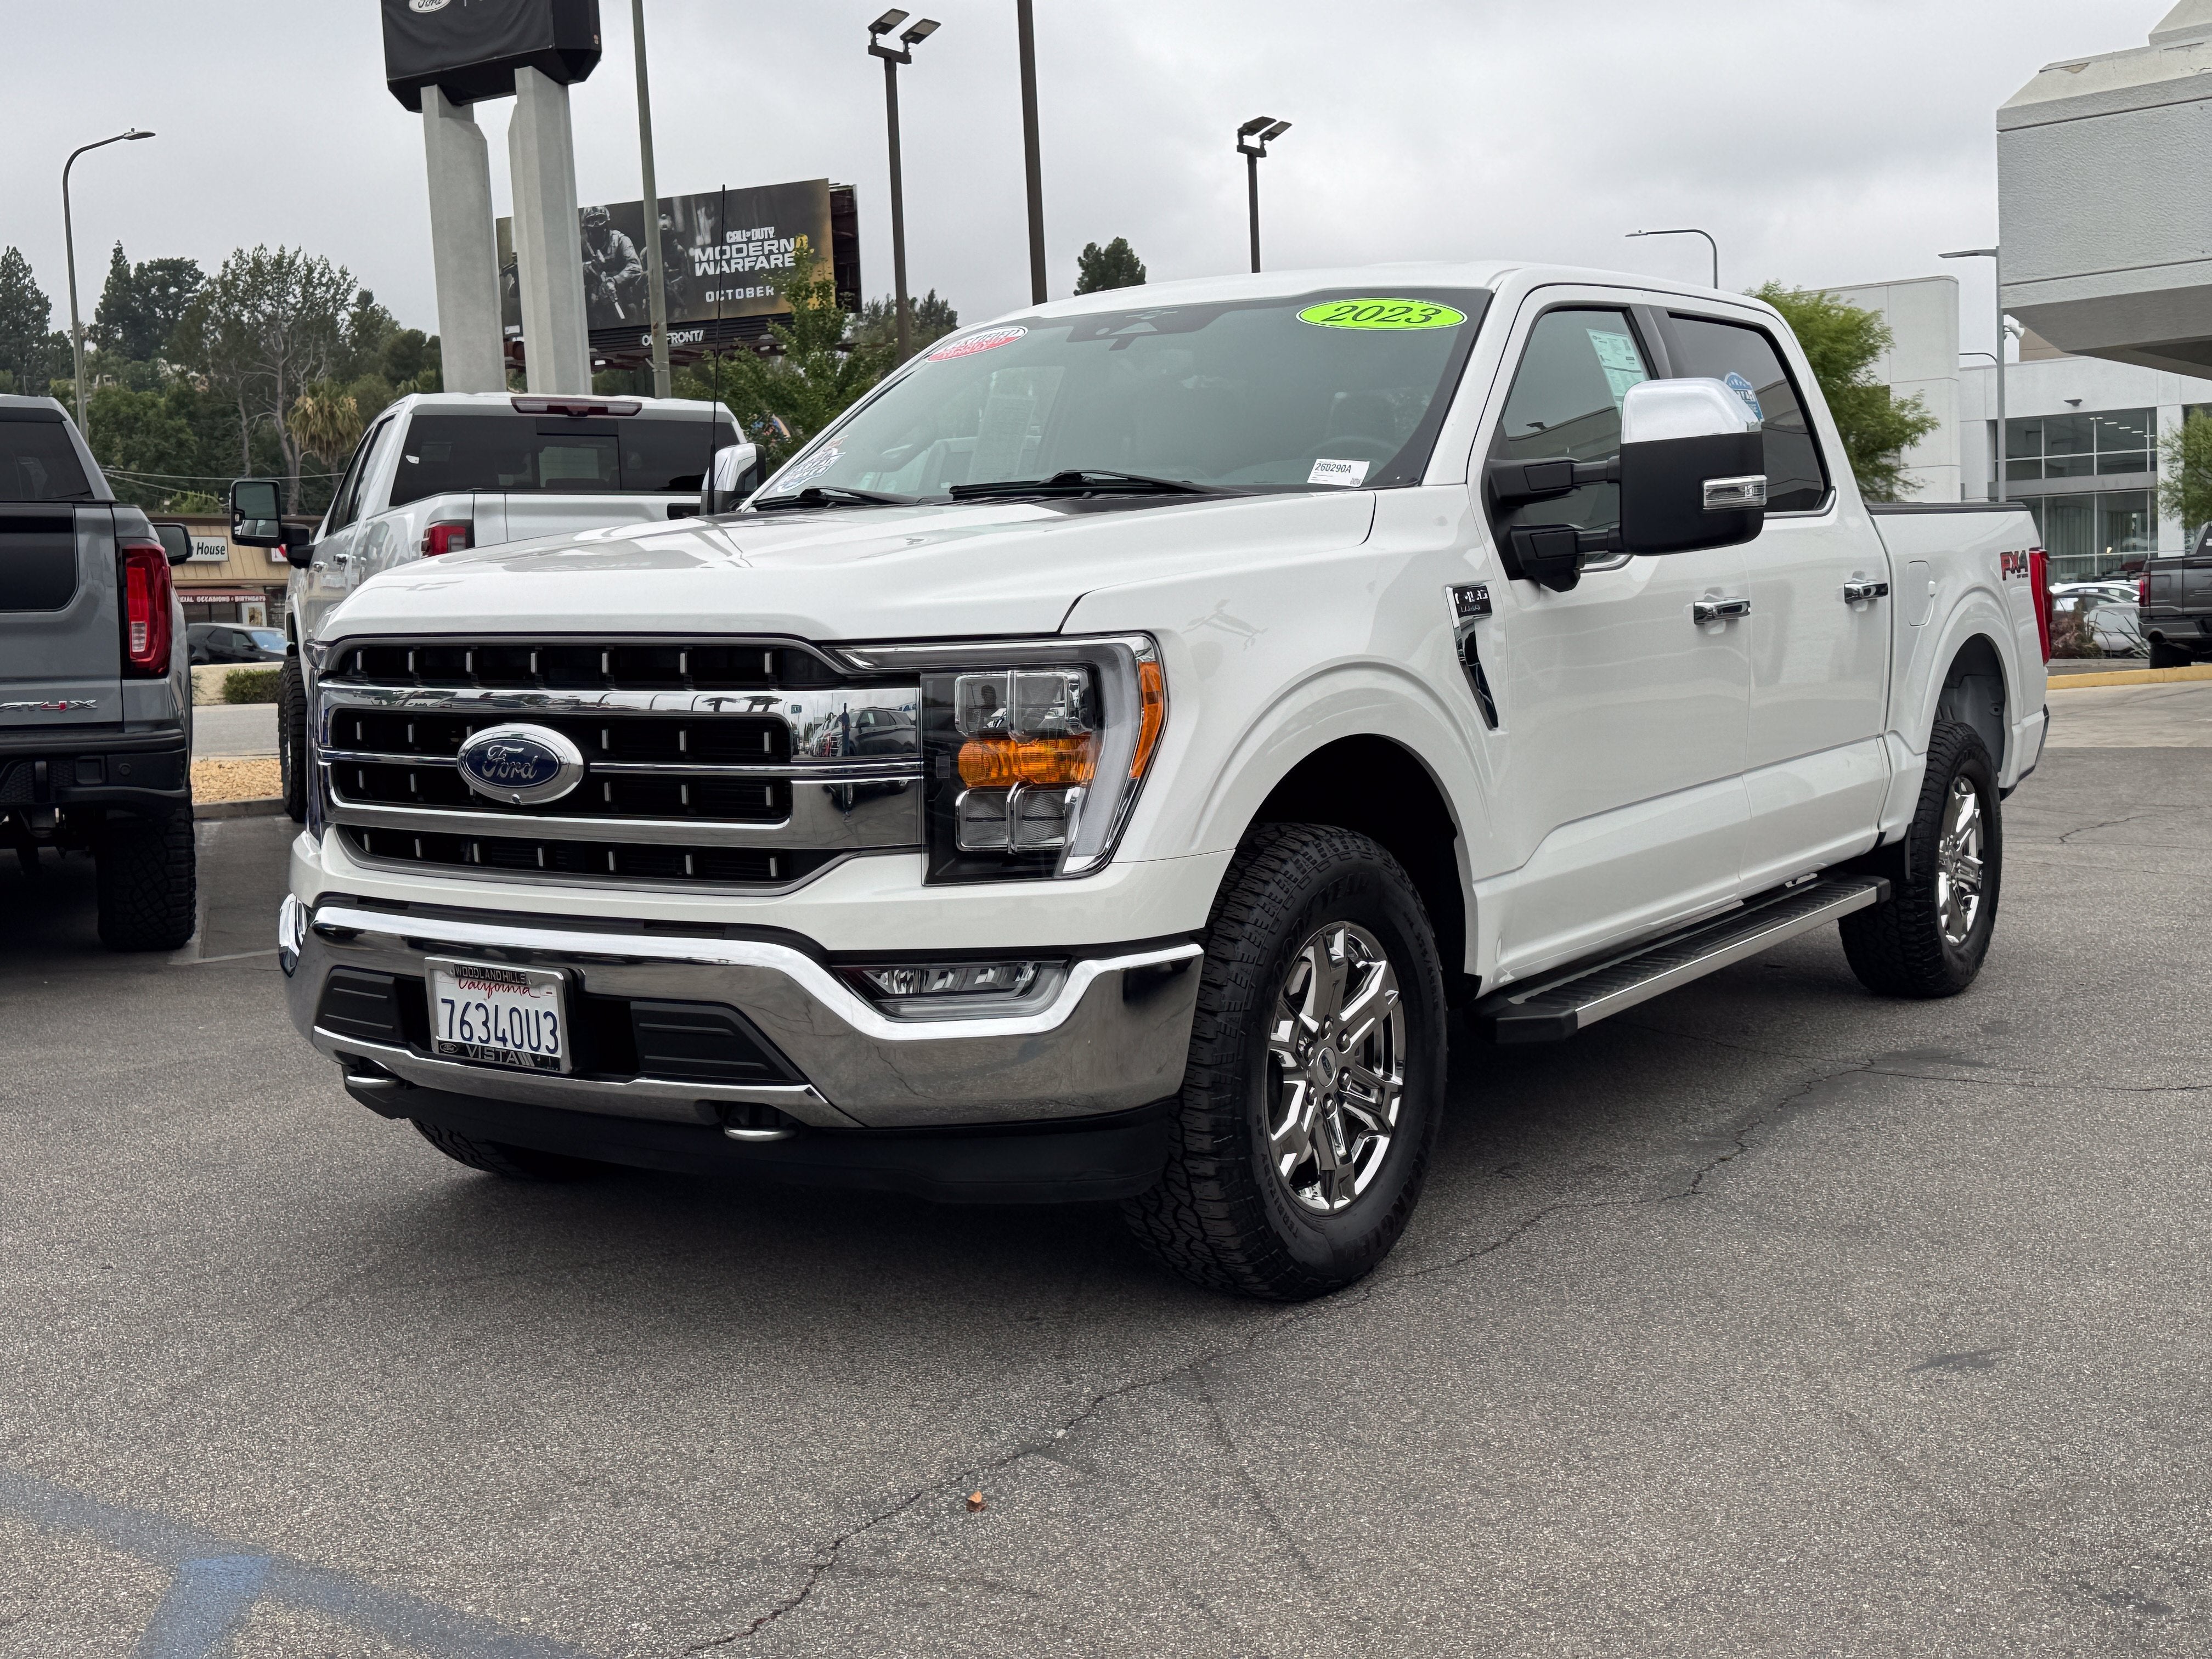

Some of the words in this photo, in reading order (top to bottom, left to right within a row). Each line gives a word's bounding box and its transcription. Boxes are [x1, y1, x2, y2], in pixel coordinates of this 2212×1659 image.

[751, 227, 775, 240] DUTY
[695, 238, 795, 262] MODERN
[695, 253, 796, 276] WARFARE
[706, 285, 775, 302] OCTOBER
[1321, 306, 1442, 323] 2023
[1315, 463, 1352, 473] 260290A
[196, 542, 225, 555] House
[482, 745, 539, 779] Ford
[455, 965, 502, 983] WOODLAND
[458, 978, 541, 1000] California
[466, 1043, 520, 1065] VISTA
